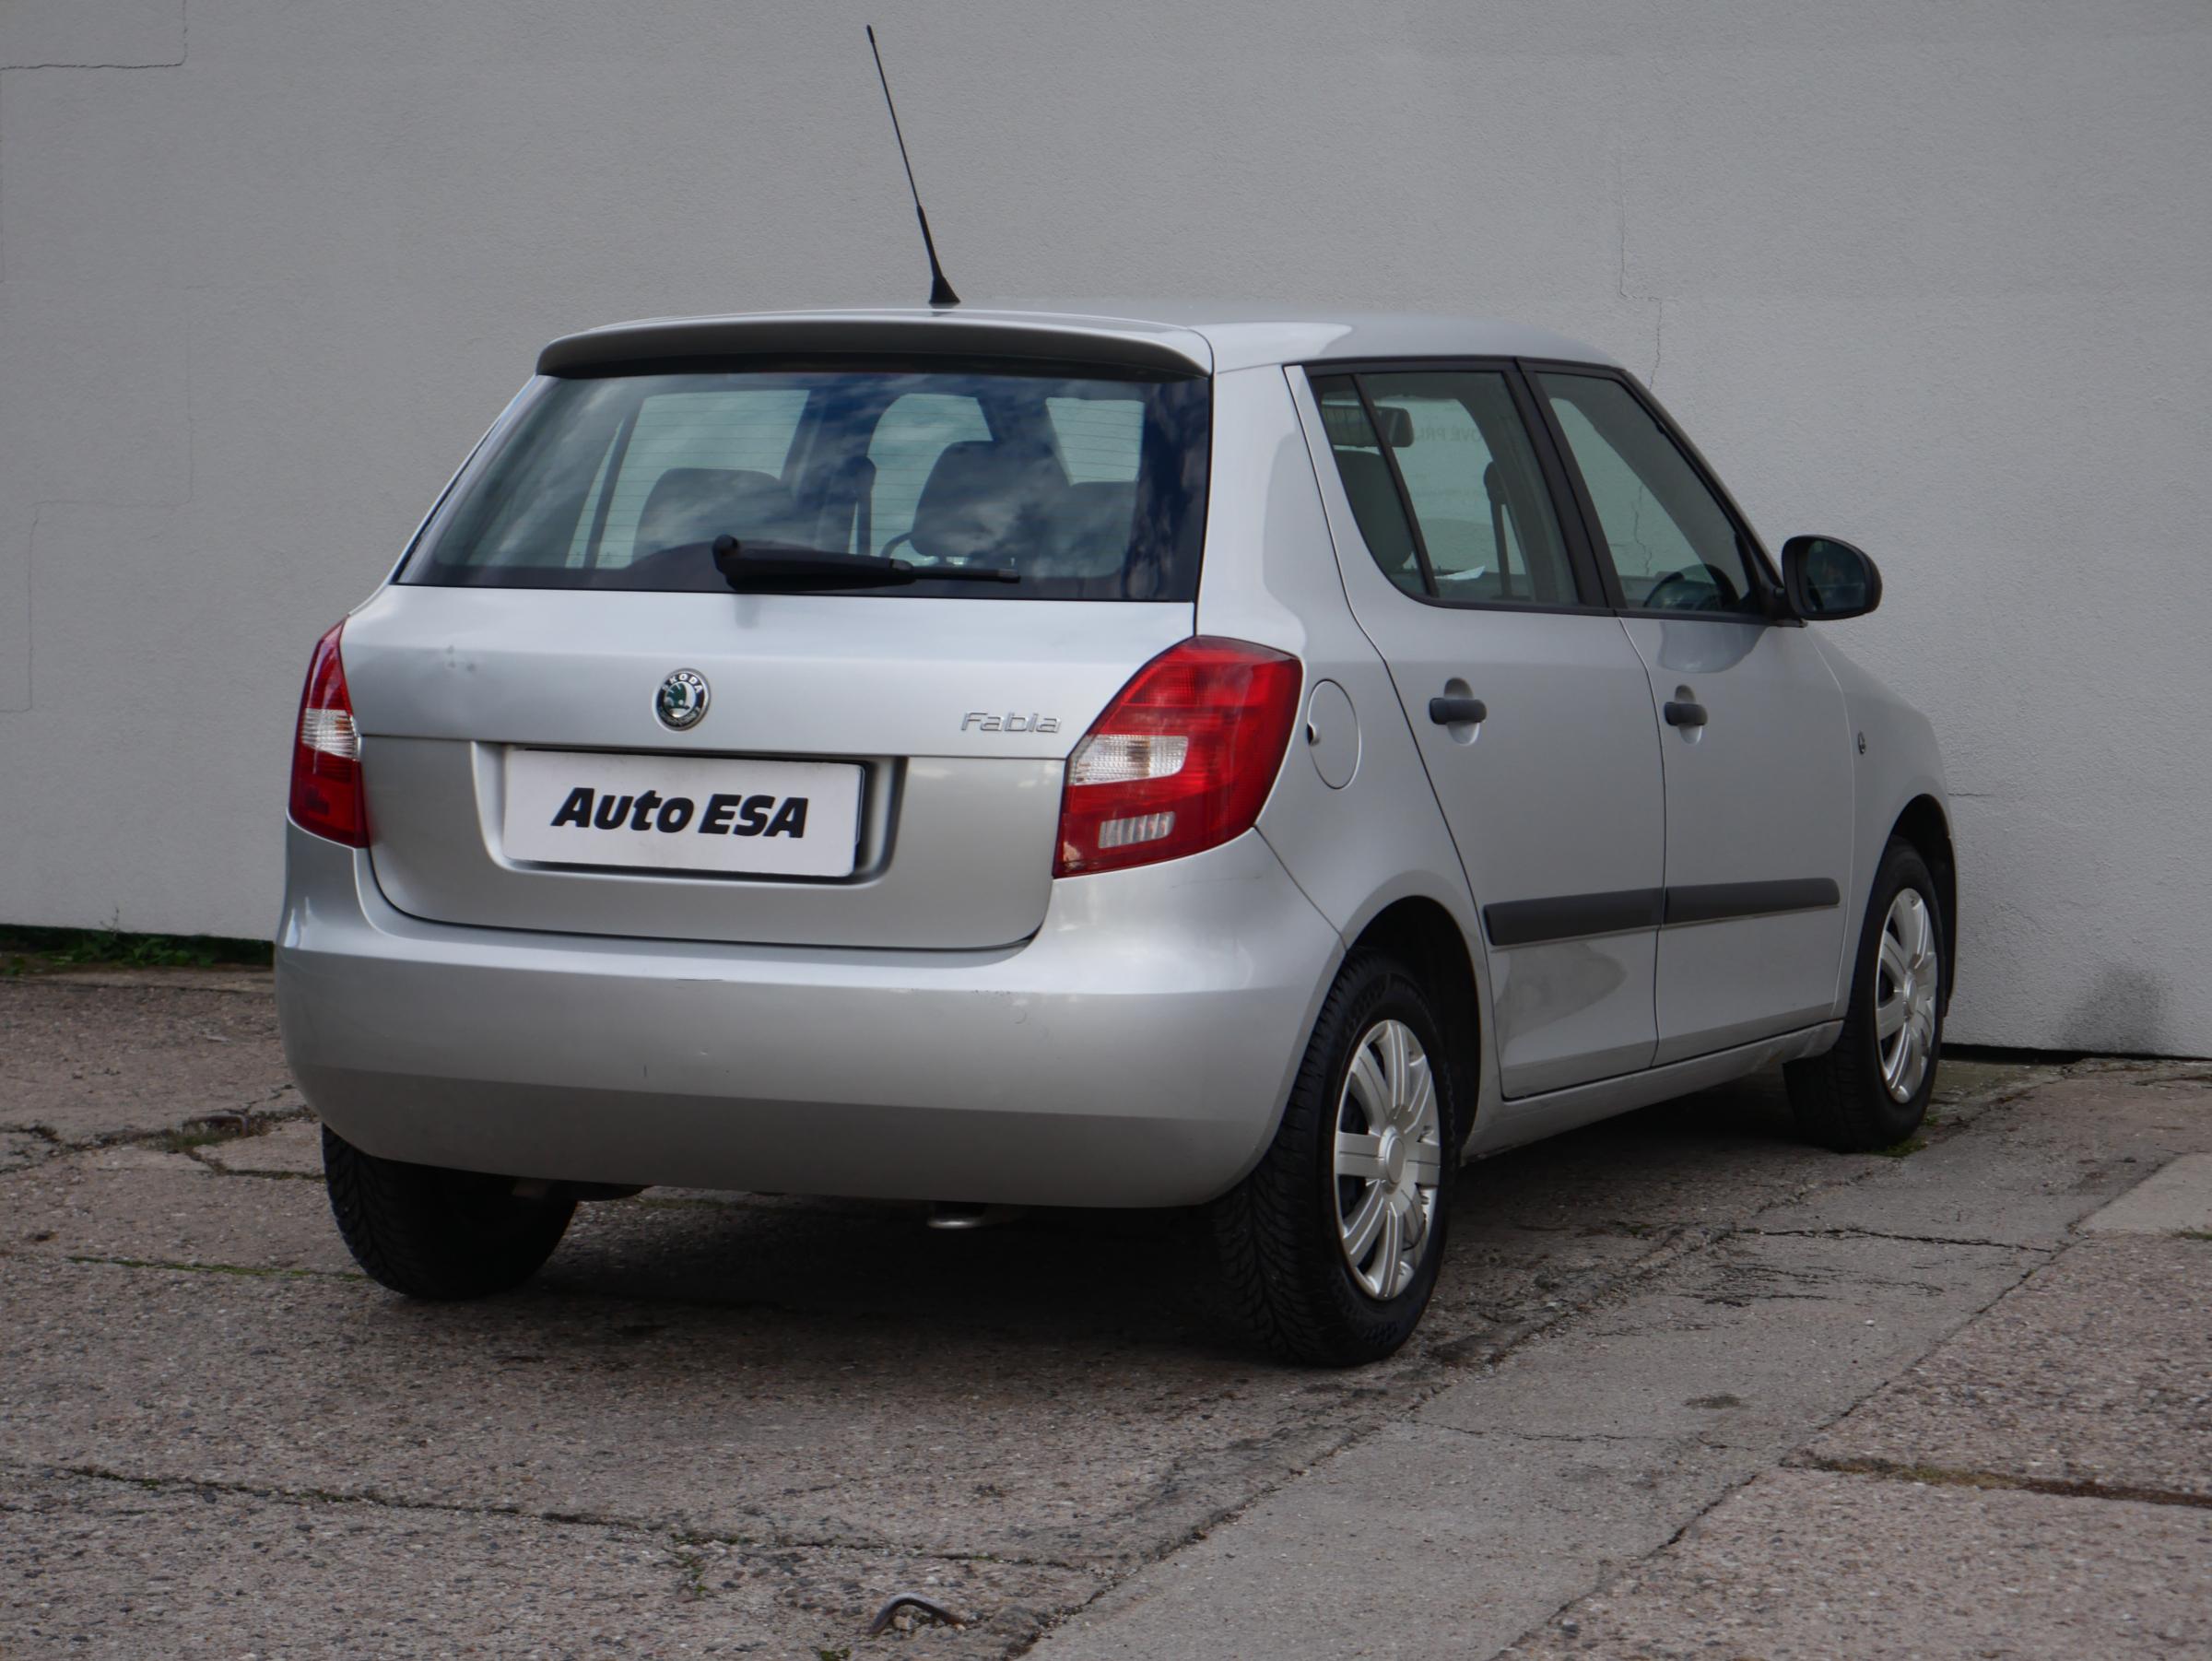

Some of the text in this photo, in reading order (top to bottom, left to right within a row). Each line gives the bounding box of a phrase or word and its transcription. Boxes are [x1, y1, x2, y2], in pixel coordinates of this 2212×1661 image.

[961, 712, 1062, 733] Fabia
[550, 787, 809, 839] Auto ESA
